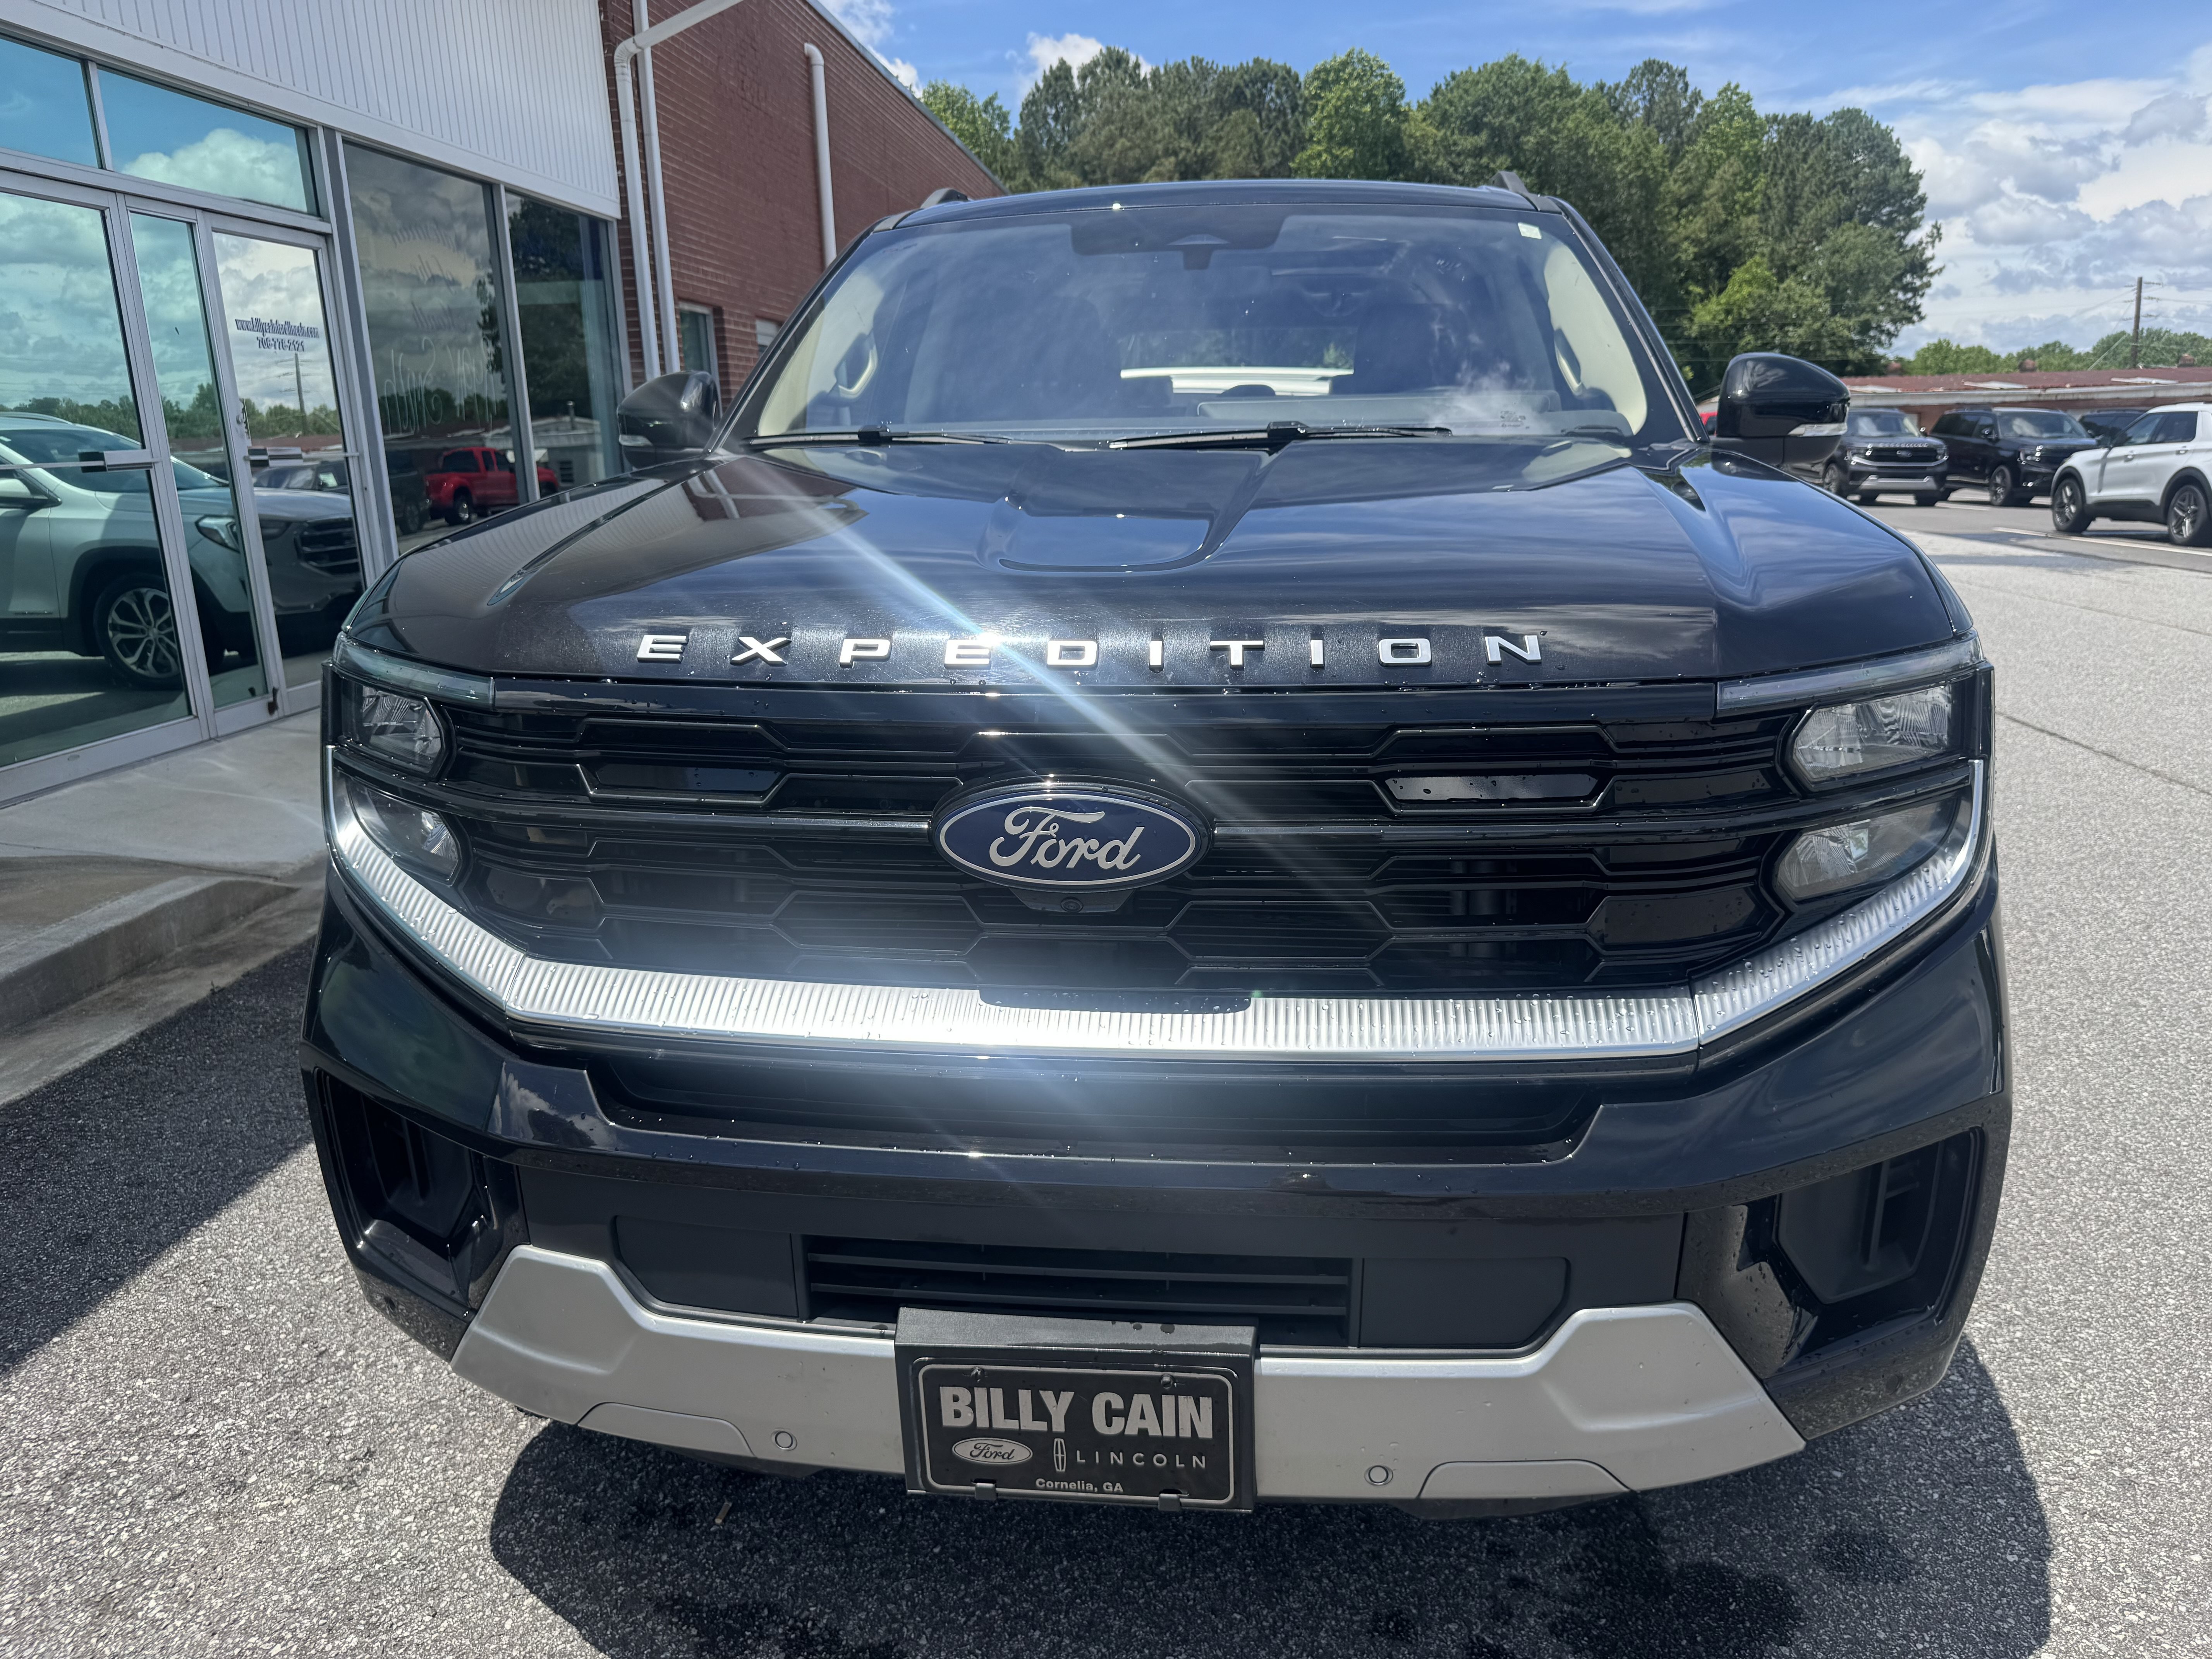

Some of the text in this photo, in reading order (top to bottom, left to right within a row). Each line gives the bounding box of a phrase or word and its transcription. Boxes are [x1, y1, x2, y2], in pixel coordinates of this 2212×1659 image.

[636, 634, 1542, 669] EXPEDITION
[989, 806, 1145, 871] Ford
[939, 1386, 1213, 1438] BILLY CAIN
[969, 1442, 1015, 1460] Ford
[1077, 1450, 1205, 1468] LINCOLN
[1036, 1478, 1124, 1492] Cornelia, GA
